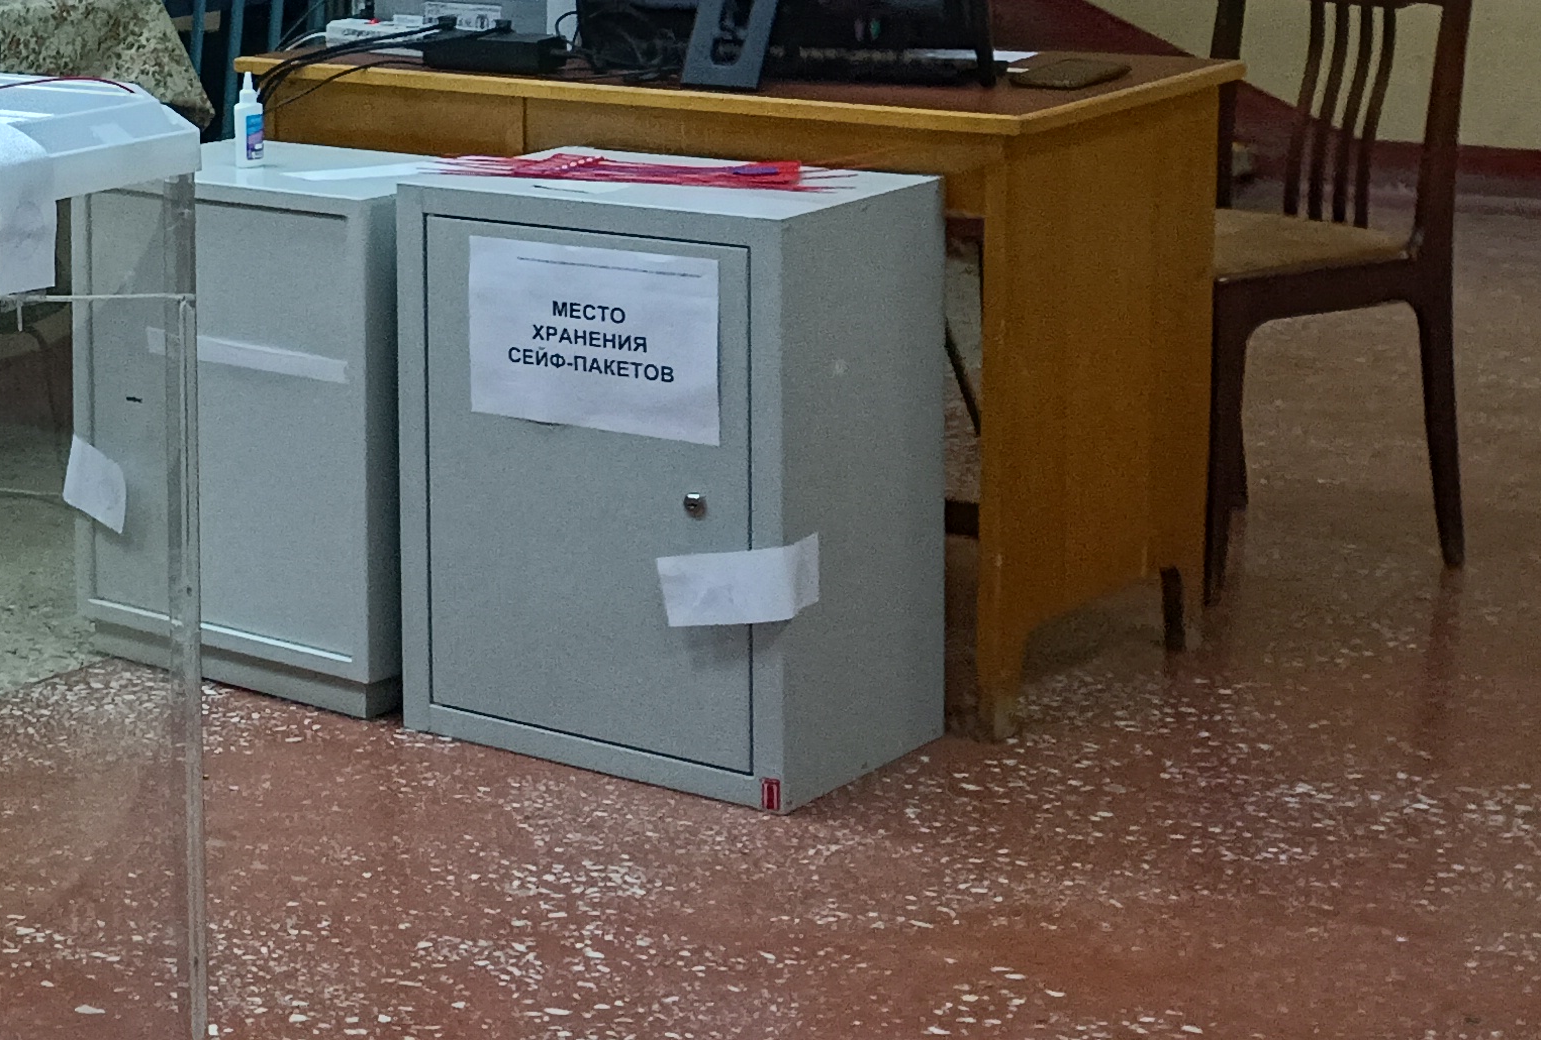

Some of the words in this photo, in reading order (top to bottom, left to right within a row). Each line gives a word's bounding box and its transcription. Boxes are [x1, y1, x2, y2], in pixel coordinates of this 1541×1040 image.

[552, 300, 626, 324] МЕСТО
[532, 324, 648, 353] ХРАНЕНИЯ
[508, 346, 675, 383] СЕЙФ-ПАКЕТОВ
